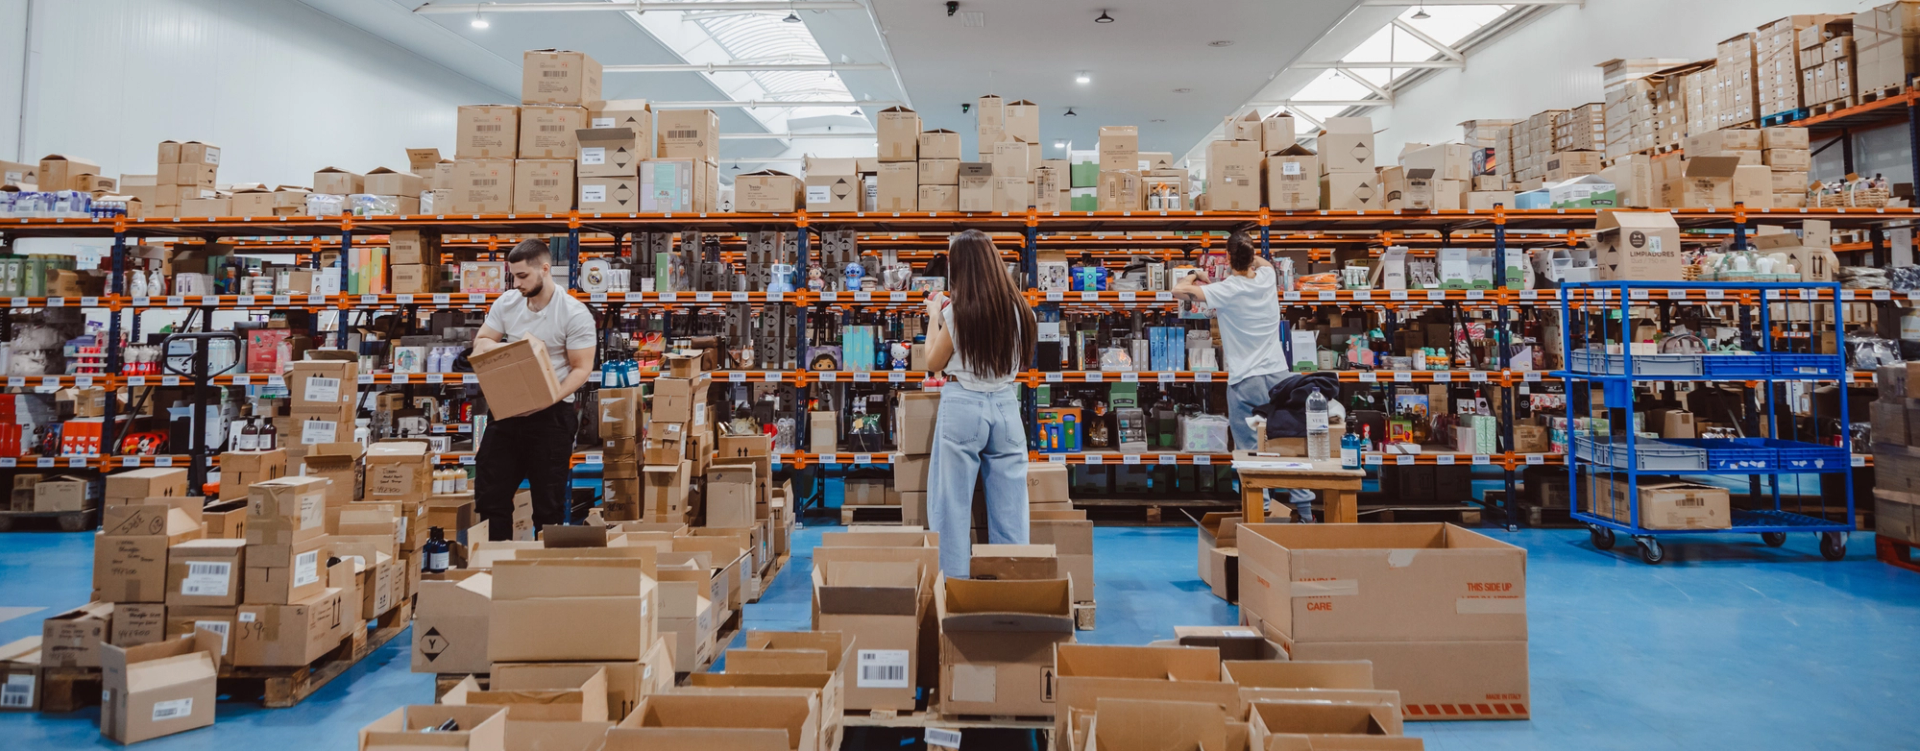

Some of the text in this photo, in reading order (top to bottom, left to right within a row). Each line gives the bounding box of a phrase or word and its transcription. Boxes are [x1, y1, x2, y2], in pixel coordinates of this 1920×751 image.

[1466, 582, 1512, 592] THIS SIDE UP
[1306, 602, 1333, 611] CARE
[428, 638, 437, 650] Y
